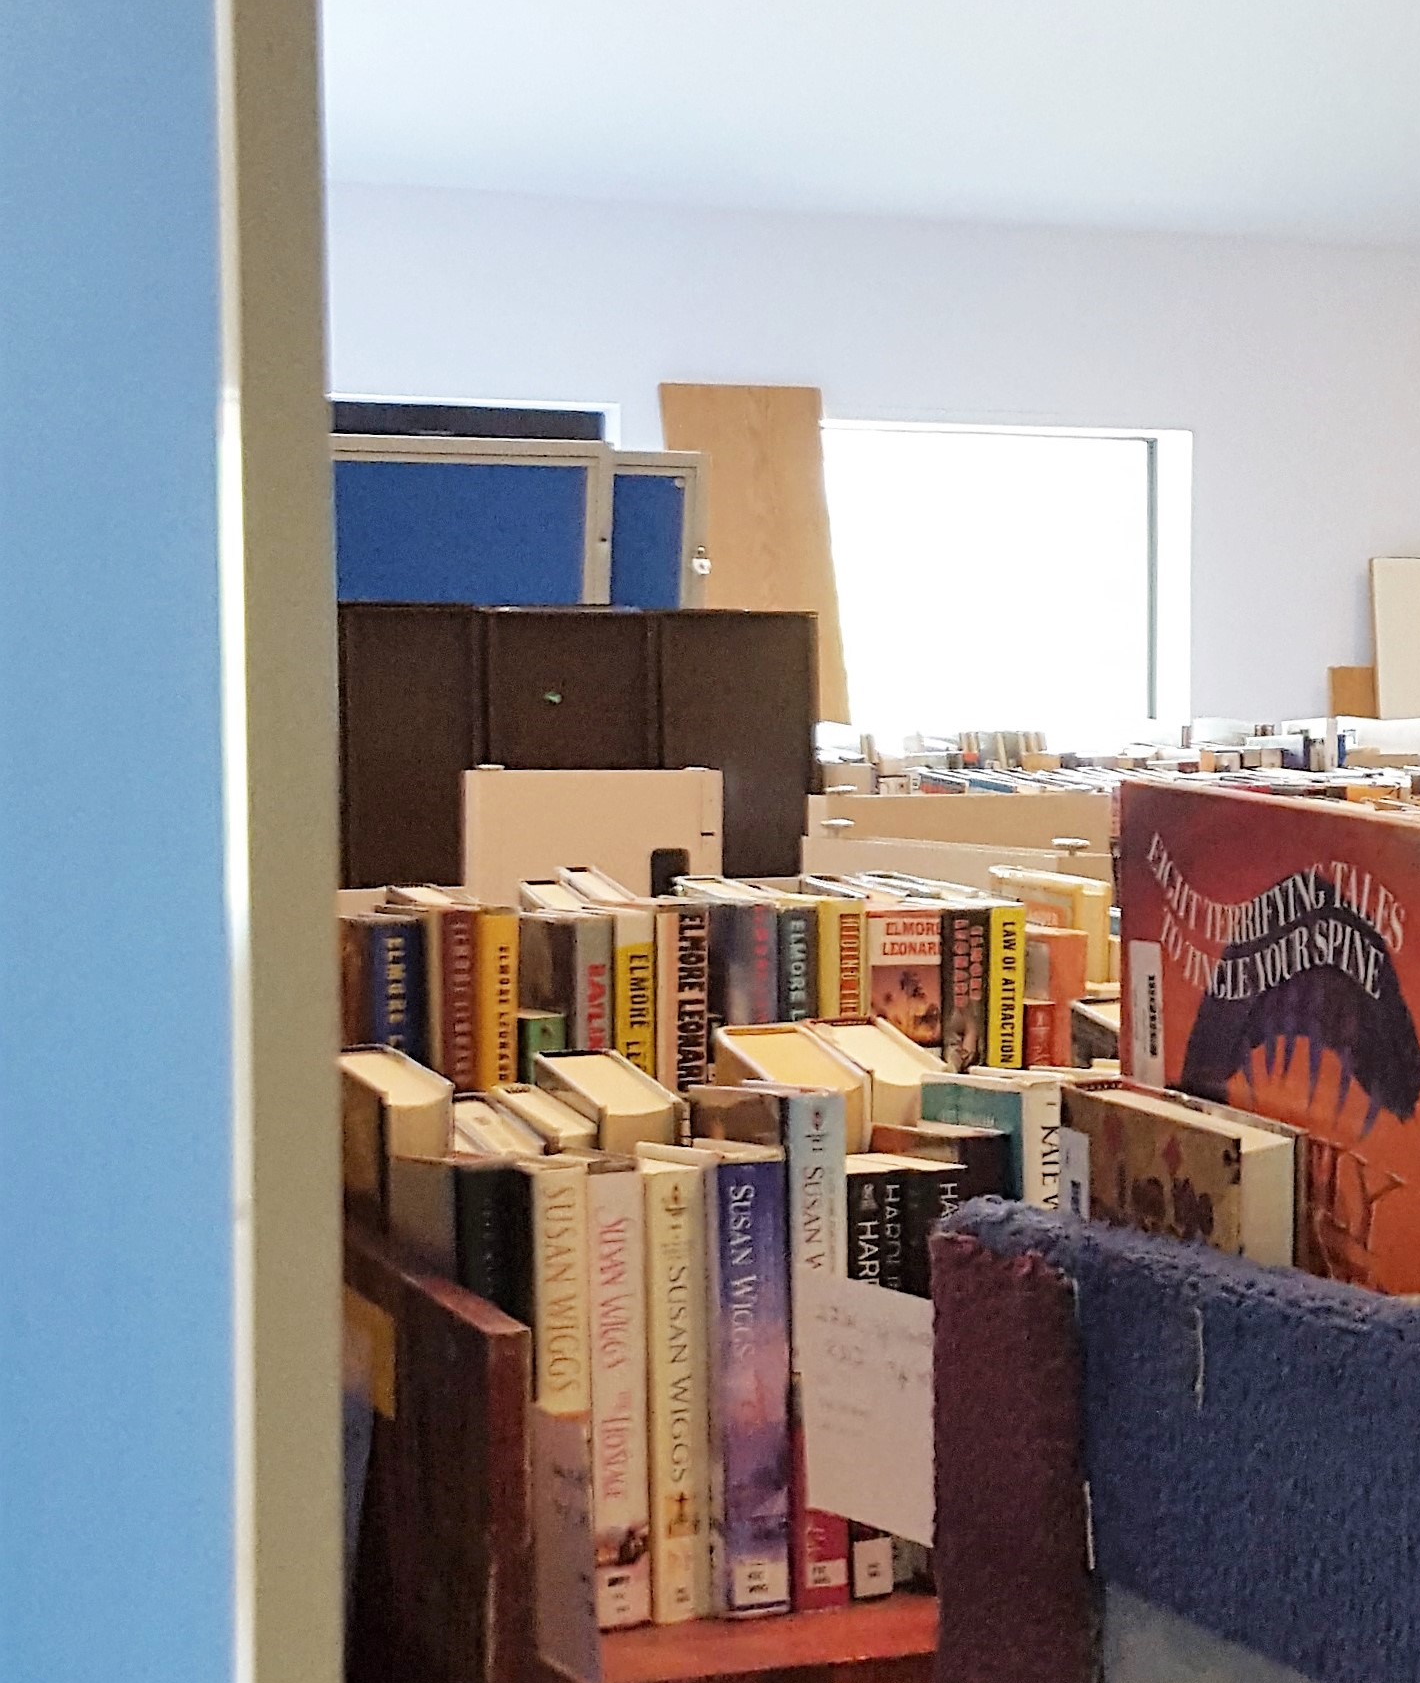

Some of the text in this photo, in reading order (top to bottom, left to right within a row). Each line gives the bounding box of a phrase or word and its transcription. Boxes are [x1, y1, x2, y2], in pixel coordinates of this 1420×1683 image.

[1146, 831, 1406, 954] EIGHT TERRIFYING TALES
[497, 945, 511, 1007] ELMORE
[628, 953, 652, 1029] ELMORE
[677, 914, 707, 995] ELMORE
[788, 919, 807, 1004] ELMORE
[999, 921, 1016, 1069] LAW OF ATTRACTION
[1160, 907, 1385, 1001] TO TINGLE YOUR SPINE
[804, 1166, 826, 1247] SUSAN
[543, 1185, 577, 1394] SUSAN WIGGS
[728, 1183, 757, 1364] SUSAN WIGGS
[665, 1263, 692, 1484] SUSAN WIGGS
